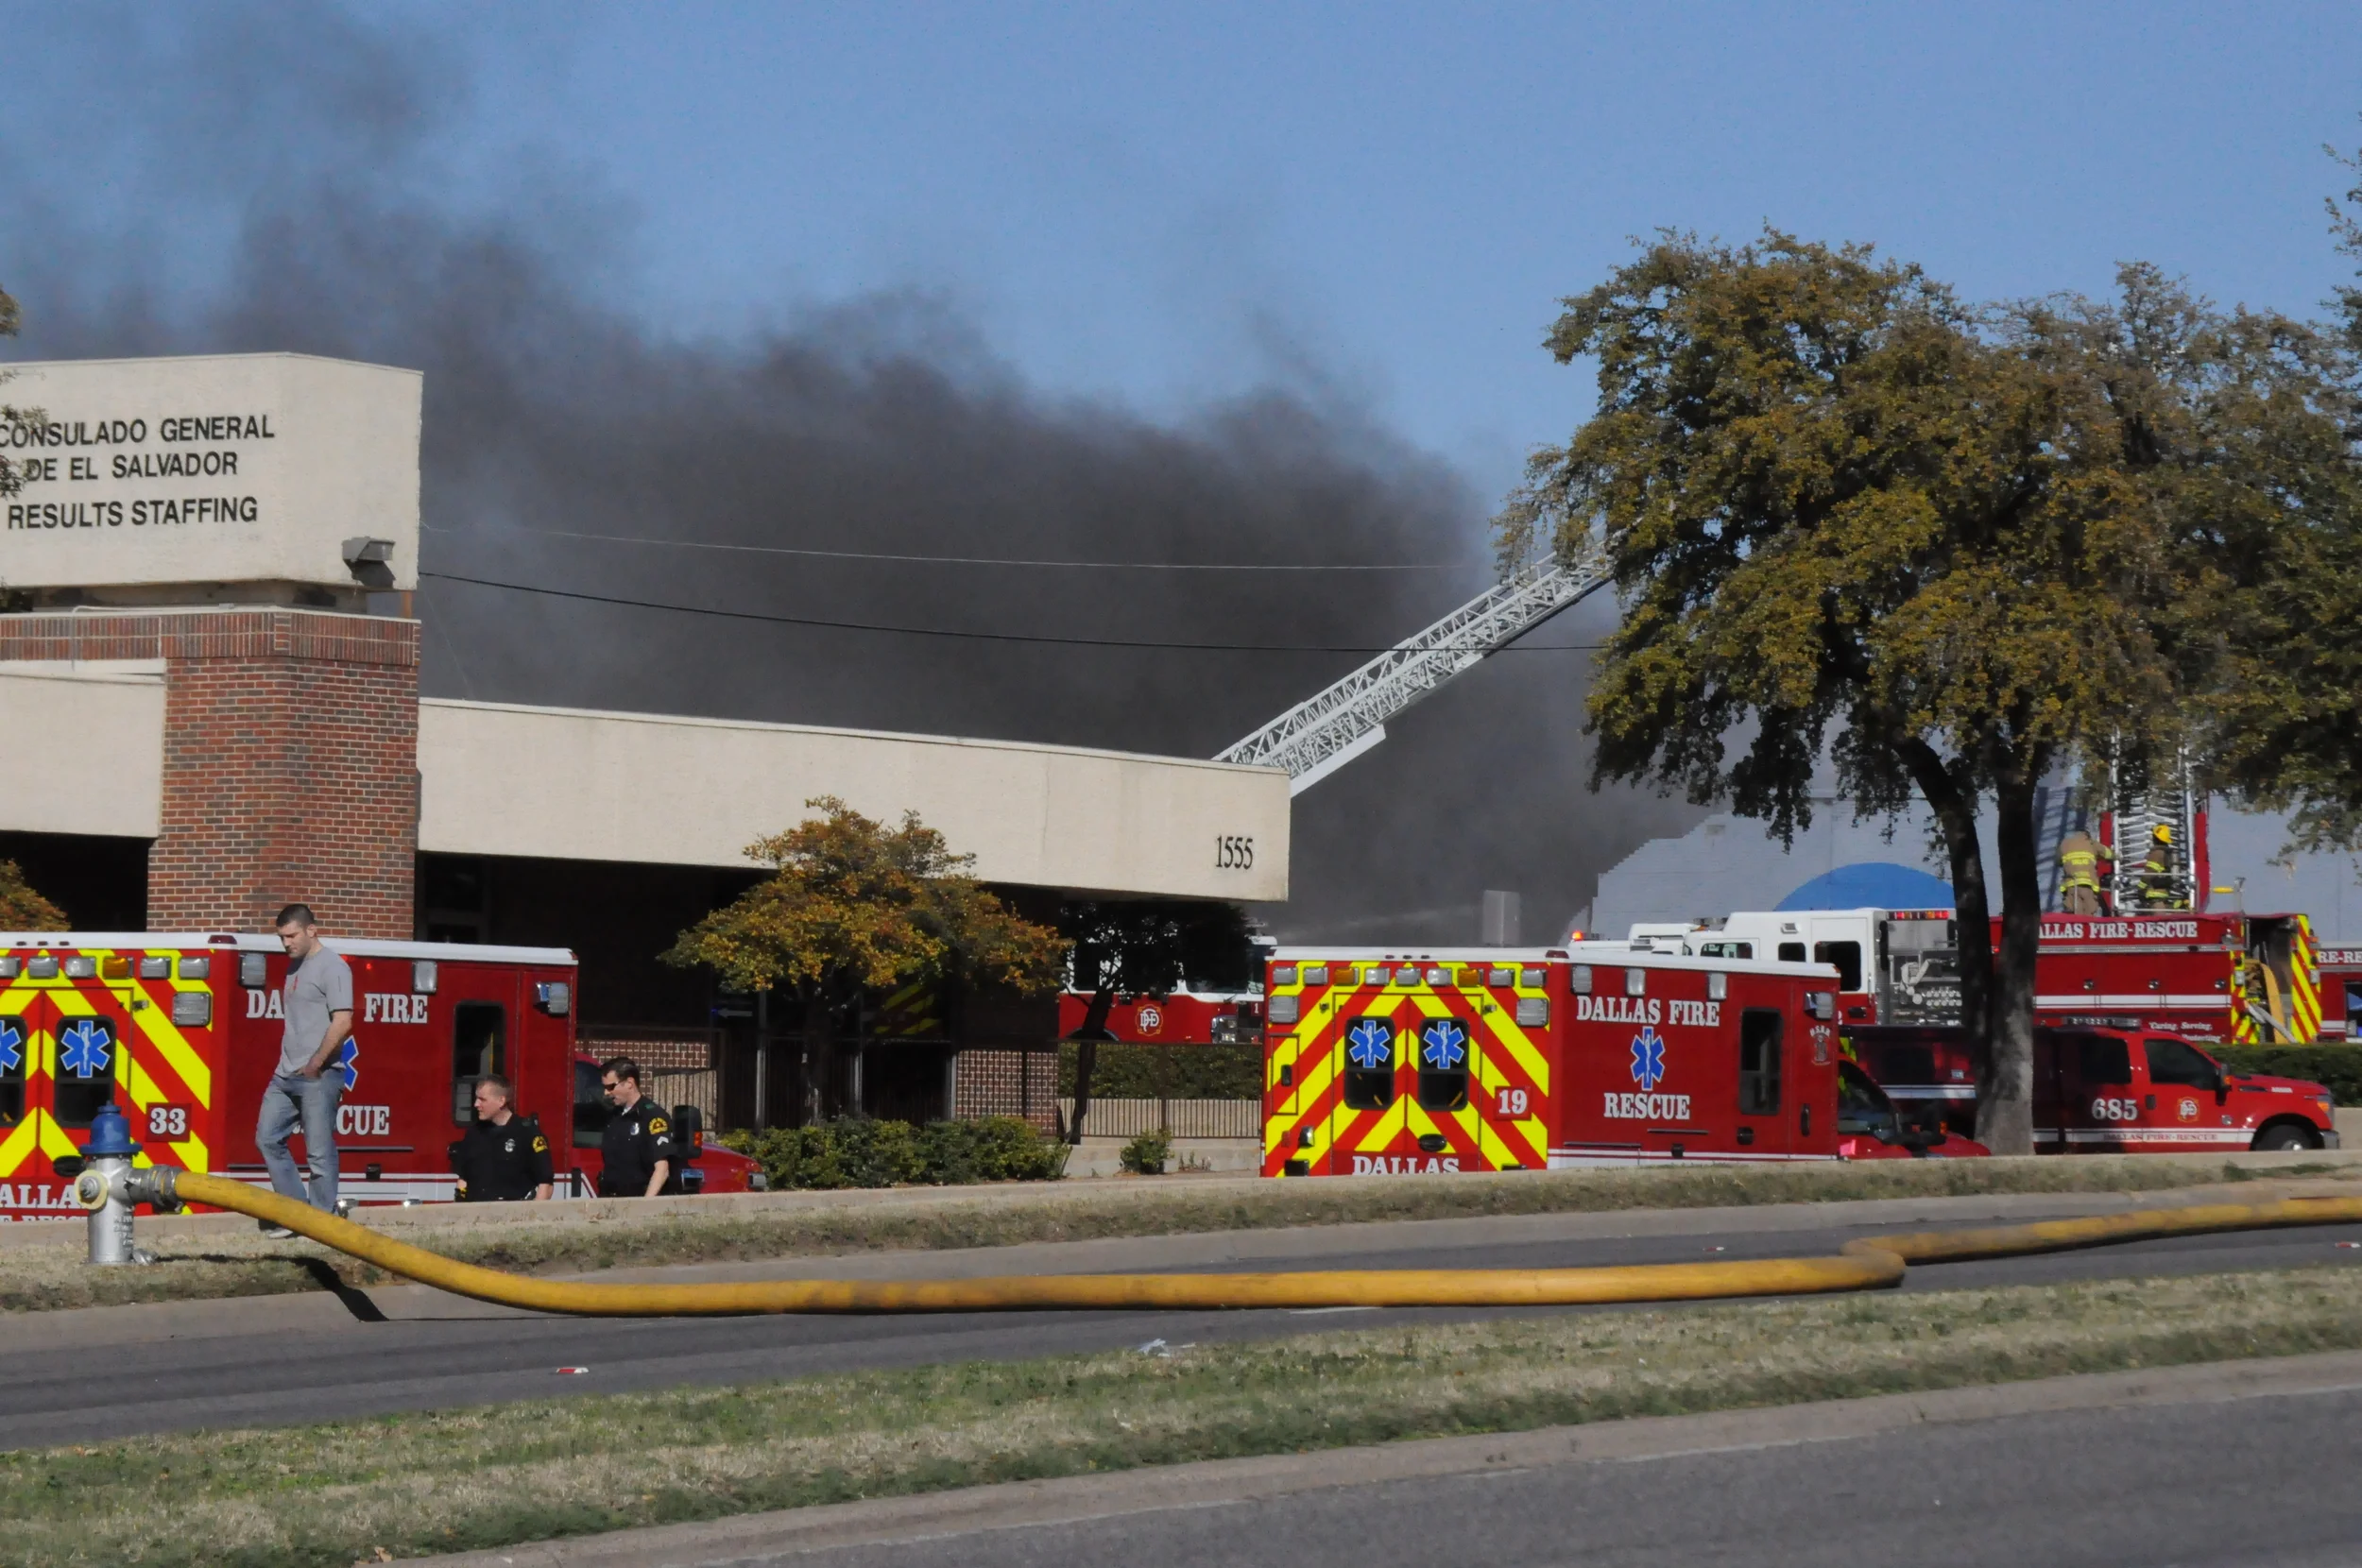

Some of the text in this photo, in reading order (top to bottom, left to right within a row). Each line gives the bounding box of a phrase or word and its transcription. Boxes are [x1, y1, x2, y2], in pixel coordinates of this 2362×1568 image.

[0, 415, 275, 449] CONSULADO GENERAL
[25, 452, 238, 482] DE EL SALVADOR
[8, 496, 258, 530] RESULTS STAFFING
[1215, 835, 1254, 870] 1555
[2039, 923, 2083, 939] ALLAS
[364, 993, 428, 1024] FIRE
[1576, 996, 1720, 1027] DALLAS FIRE
[1498, 1089, 1528, 1115] 19
[1603, 1092, 1690, 1120] RESCUE
[2091, 1099, 2138, 1121] 685
[149, 1107, 186, 1135] 33
[335, 1104, 390, 1135] CUE
[1352, 1155, 1460, 1175] DALLAS
[0, 1184, 86, 1209] ALLA
